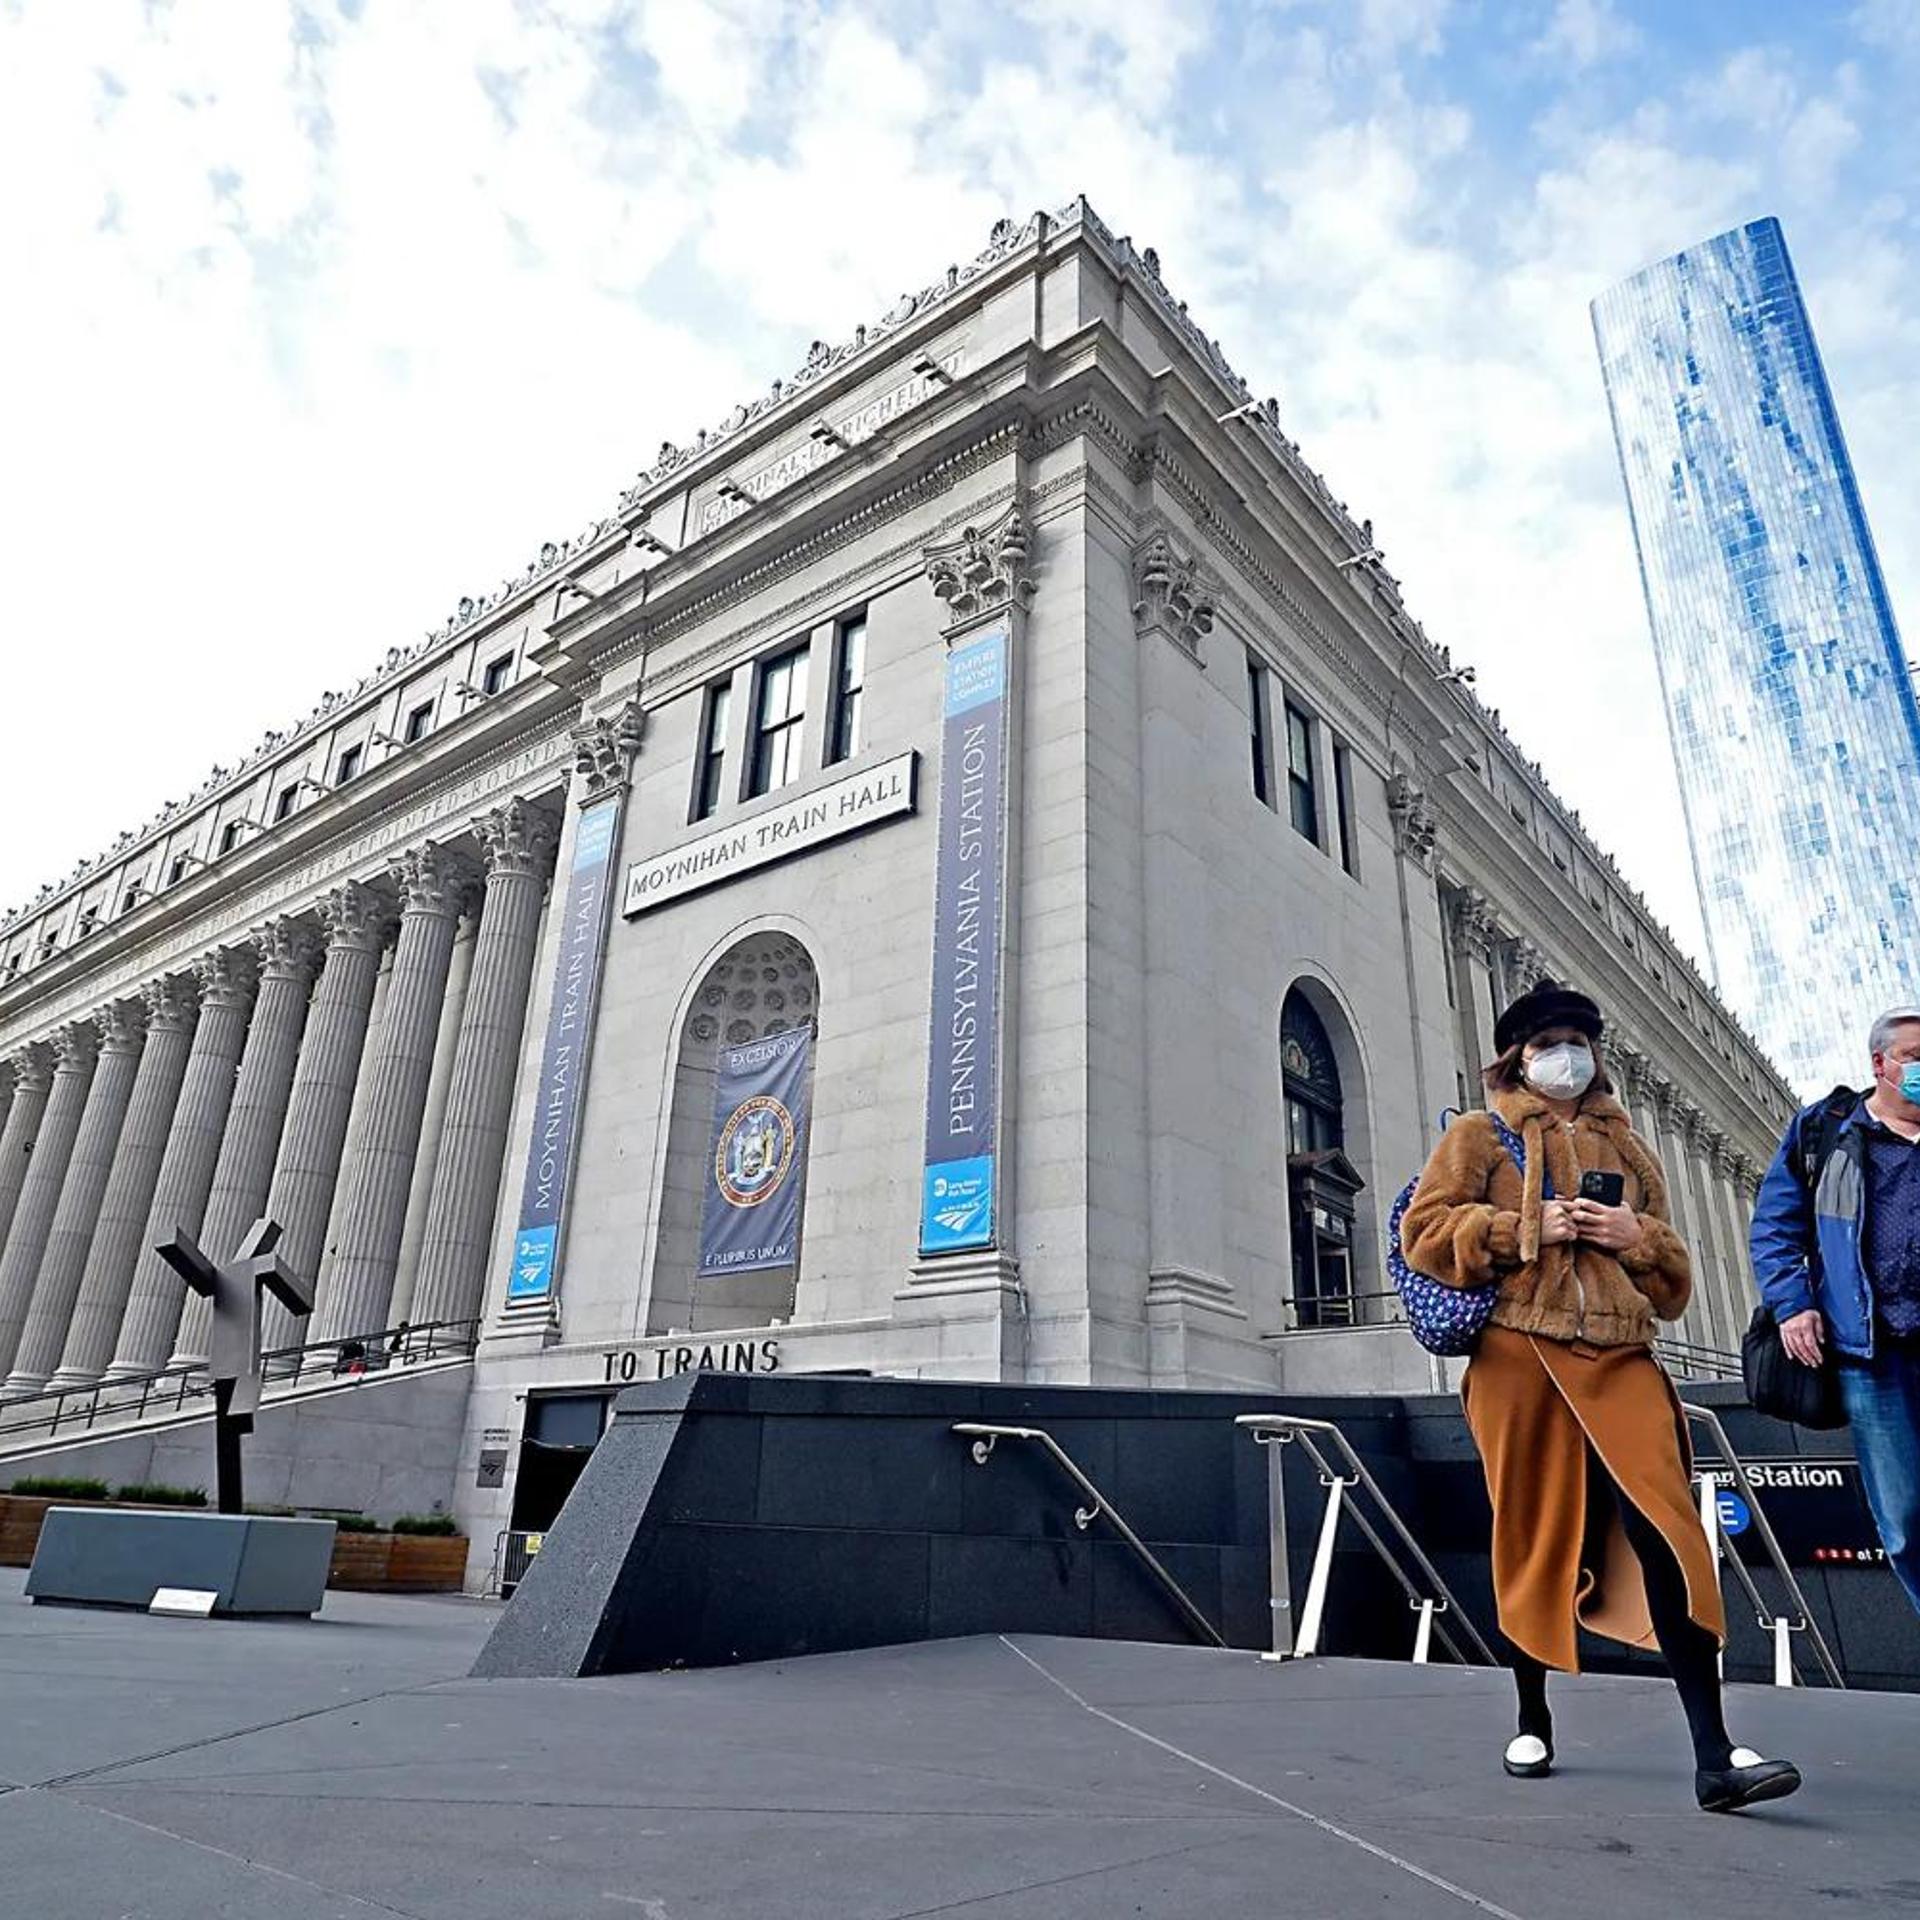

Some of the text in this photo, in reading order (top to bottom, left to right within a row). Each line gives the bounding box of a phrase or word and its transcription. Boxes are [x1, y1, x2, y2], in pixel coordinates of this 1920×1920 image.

[705, 456, 800, 521] CADINAL
[843, 356, 959, 436] RICHELIU
[630, 835, 748, 898] MOYNIHAN
[756, 803, 827, 848] TRAIN
[837, 774, 902, 818] HALL
[950, 723, 988, 1137] PENNSYLVANIA STATION
[535, 876, 596, 1208] MOYNIHAN TRAIN HALL
[603, 1340, 778, 1382] TO TRAINS
[1717, 1501, 1738, 1525] E
[1746, 1465, 1843, 1487] Station
[1856, 1548, 1872, 1561] at
[1875, 1548, 1884, 1560] 7
